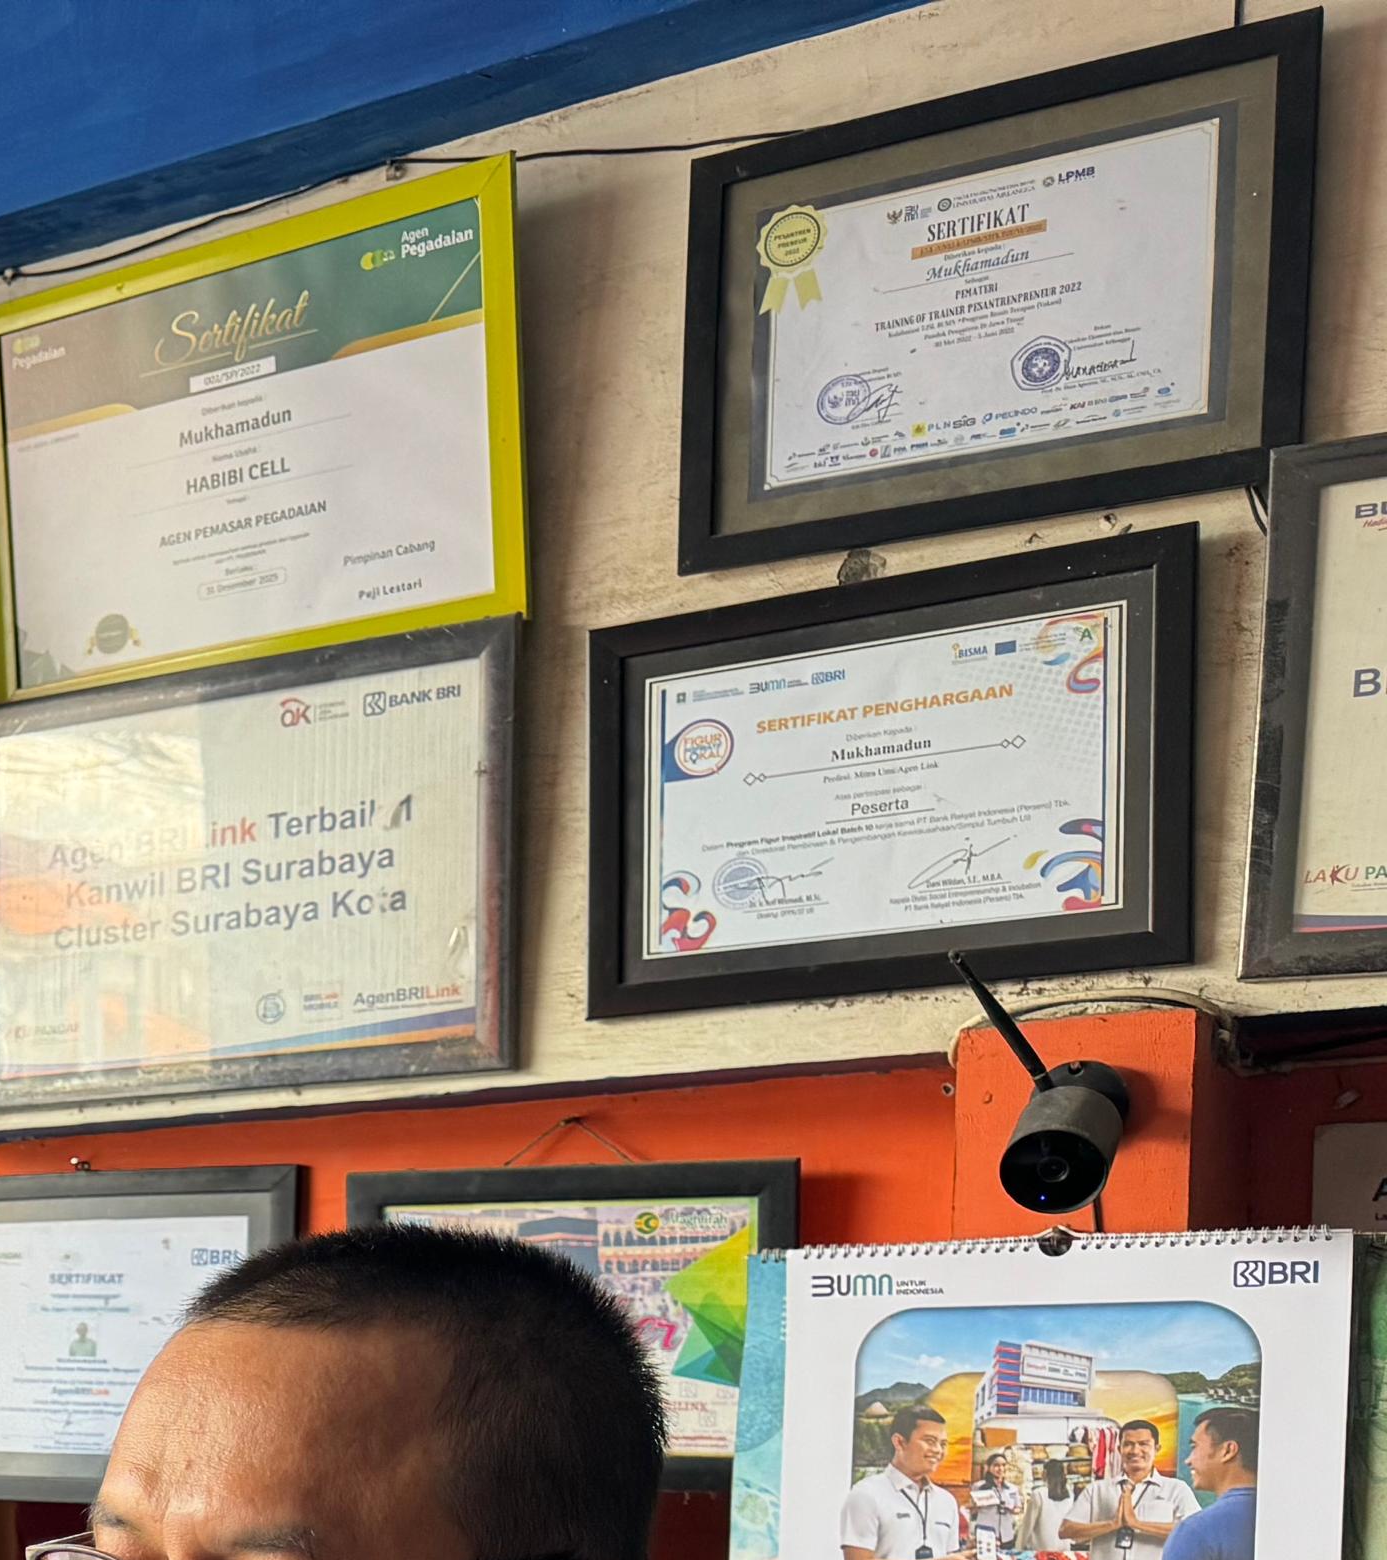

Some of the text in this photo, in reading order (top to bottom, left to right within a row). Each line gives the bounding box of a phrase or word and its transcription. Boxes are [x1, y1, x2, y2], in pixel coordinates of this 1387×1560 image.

[401, 226, 429, 244] Agen
[927, 204, 1030, 242] SERTIFIKAT
[401, 227, 474, 260] Pegadaian
[926, 250, 1030, 281] Mukhamadun
[956, 283, 998, 300] PEMATERI
[875, 316, 915, 332] TRAINING
[916, 313, 926, 323] OF
[928, 307, 965, 321] TRAINER
[1059, 282, 1083, 294] 2022
[179, 409, 292, 448] Mukhamadun
[186, 457, 290, 495] HABIBI CELL
[159, 531, 192, 548] AGEN
[195, 517, 252, 541] PEMASAR
[255, 500, 327, 527] PEGADAIAN
[343, 540, 435, 566] Pimpinan Cabang
[825, 669, 846, 683] BRI
[389, 685, 461, 707] BANK BRI
[756, 684, 1014, 734] SERTIFIKAT PENGHARGAAN
[831, 738, 932, 763] Mukhamadun
[851, 797, 909, 817] Peserta
[66, 848, 394, 909] Kanwil BRI Surabaya
[1304, 864, 1358, 886] LAKU
[54, 917, 161, 951] Cluster
[171, 899, 318, 937] Surabaya
[353, 983, 460, 1008] AgenBRILink
[49, 1273, 124, 1285] SERTIFIKAT
[1268, 1260, 1320, 1285] BRI
